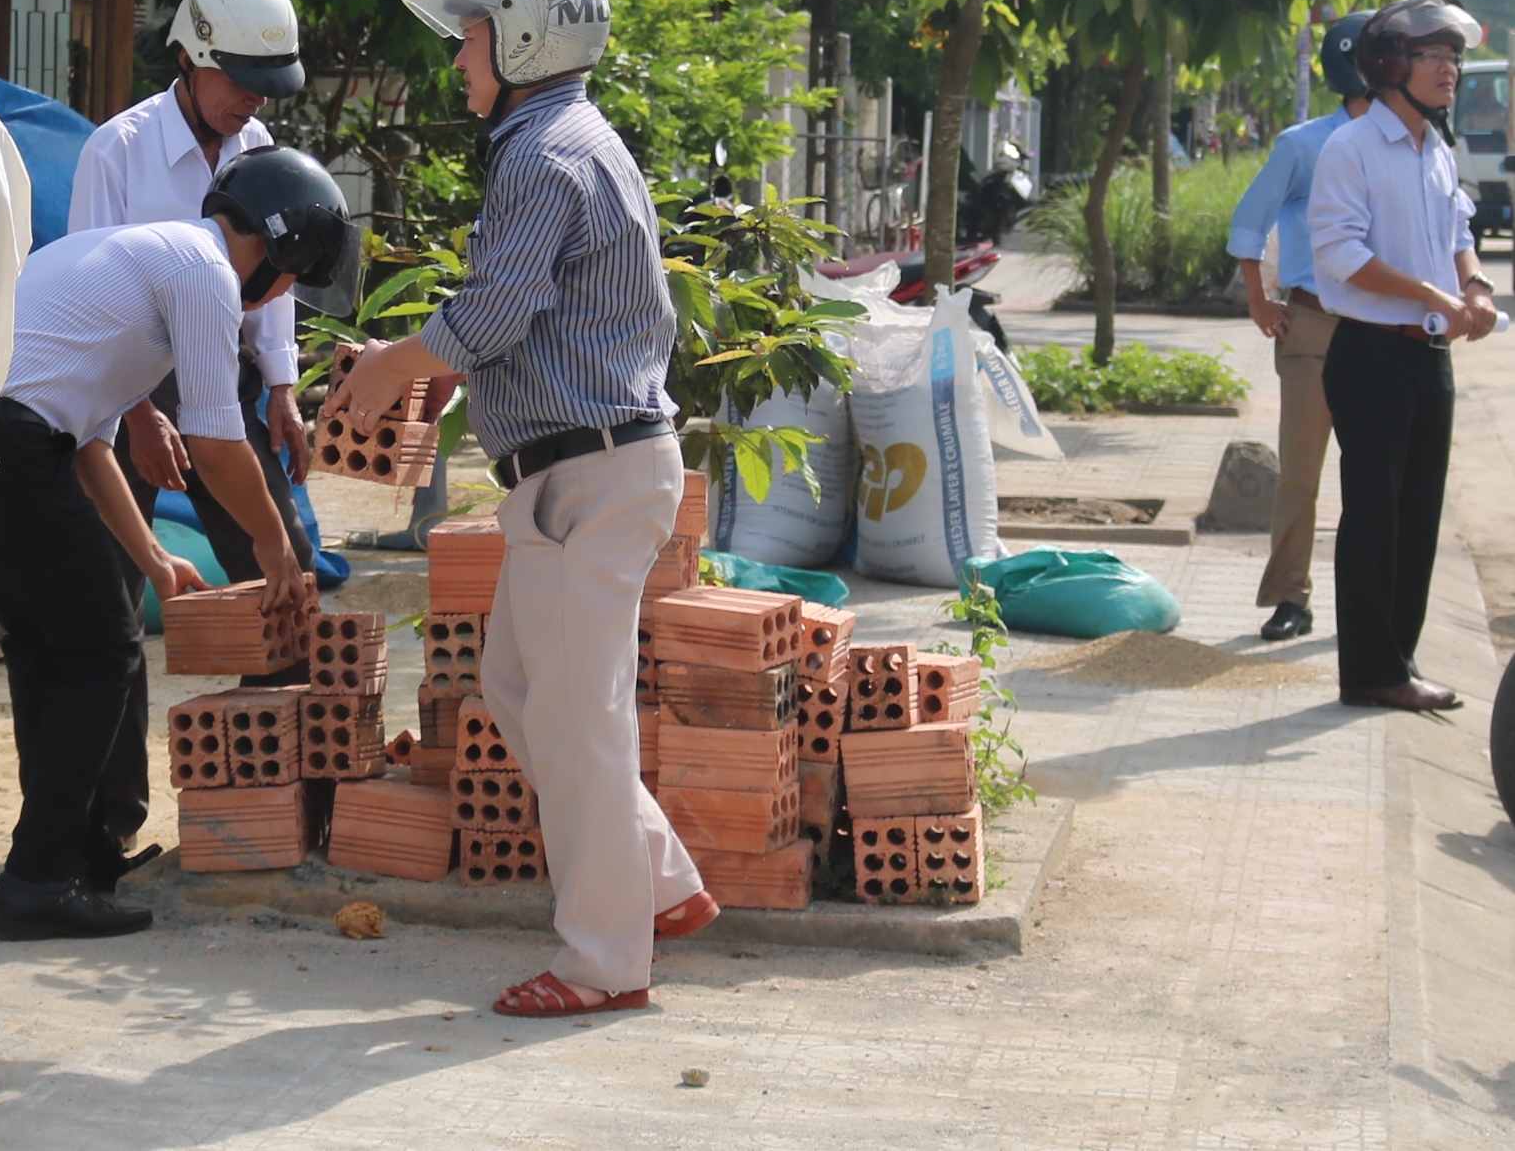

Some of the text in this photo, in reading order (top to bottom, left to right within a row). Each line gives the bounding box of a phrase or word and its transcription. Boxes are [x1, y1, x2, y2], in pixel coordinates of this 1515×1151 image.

[939, 401, 967, 560] BREEDER LAYER 2 CRUMBLE
